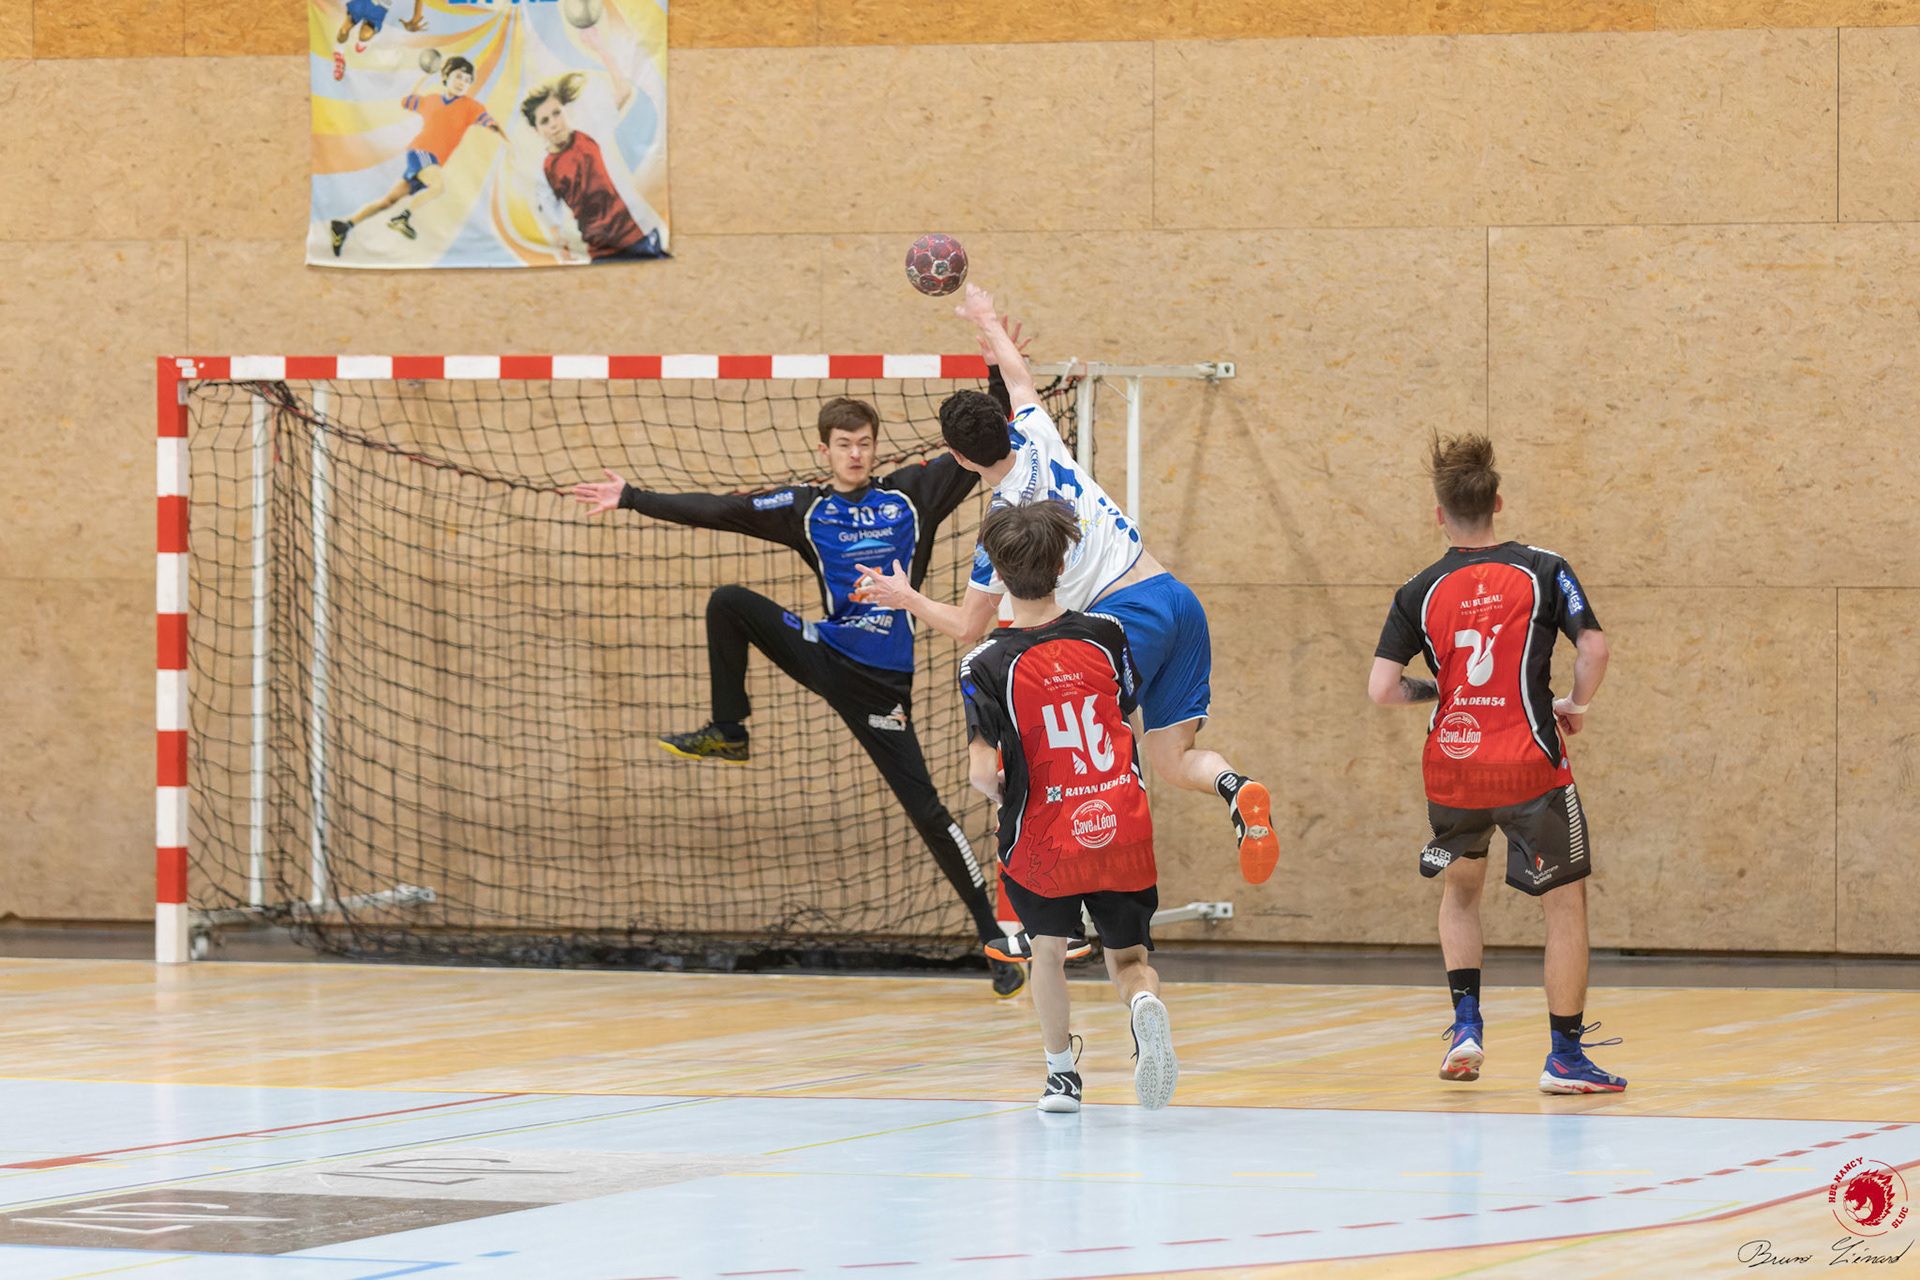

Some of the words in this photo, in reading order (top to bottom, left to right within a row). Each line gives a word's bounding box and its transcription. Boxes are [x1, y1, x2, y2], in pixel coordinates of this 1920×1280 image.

[838, 532, 858, 542] Guy
[859, 527, 894, 539] Hoquet
[1460, 600, 1472, 609] AU
[1472, 594, 1503, 607] BUREAU
[1052, 672, 1083, 683] BUREAU
[1468, 697, 1491, 706] DEM
[1491, 697, 1506, 706] 54
[1041, 693, 1115, 775] 46
[1440, 728, 1459, 743] Cave
[1462, 728, 1481, 743] Léon
[1065, 785, 1099, 797] RAYAN
[1099, 778, 1120, 792] DEM
[1119, 773, 1131, 785] 54
[1073, 819, 1094, 835] Cave
[1096, 813, 1117, 830] Léon
[1422, 853, 1450, 867] SPORT
